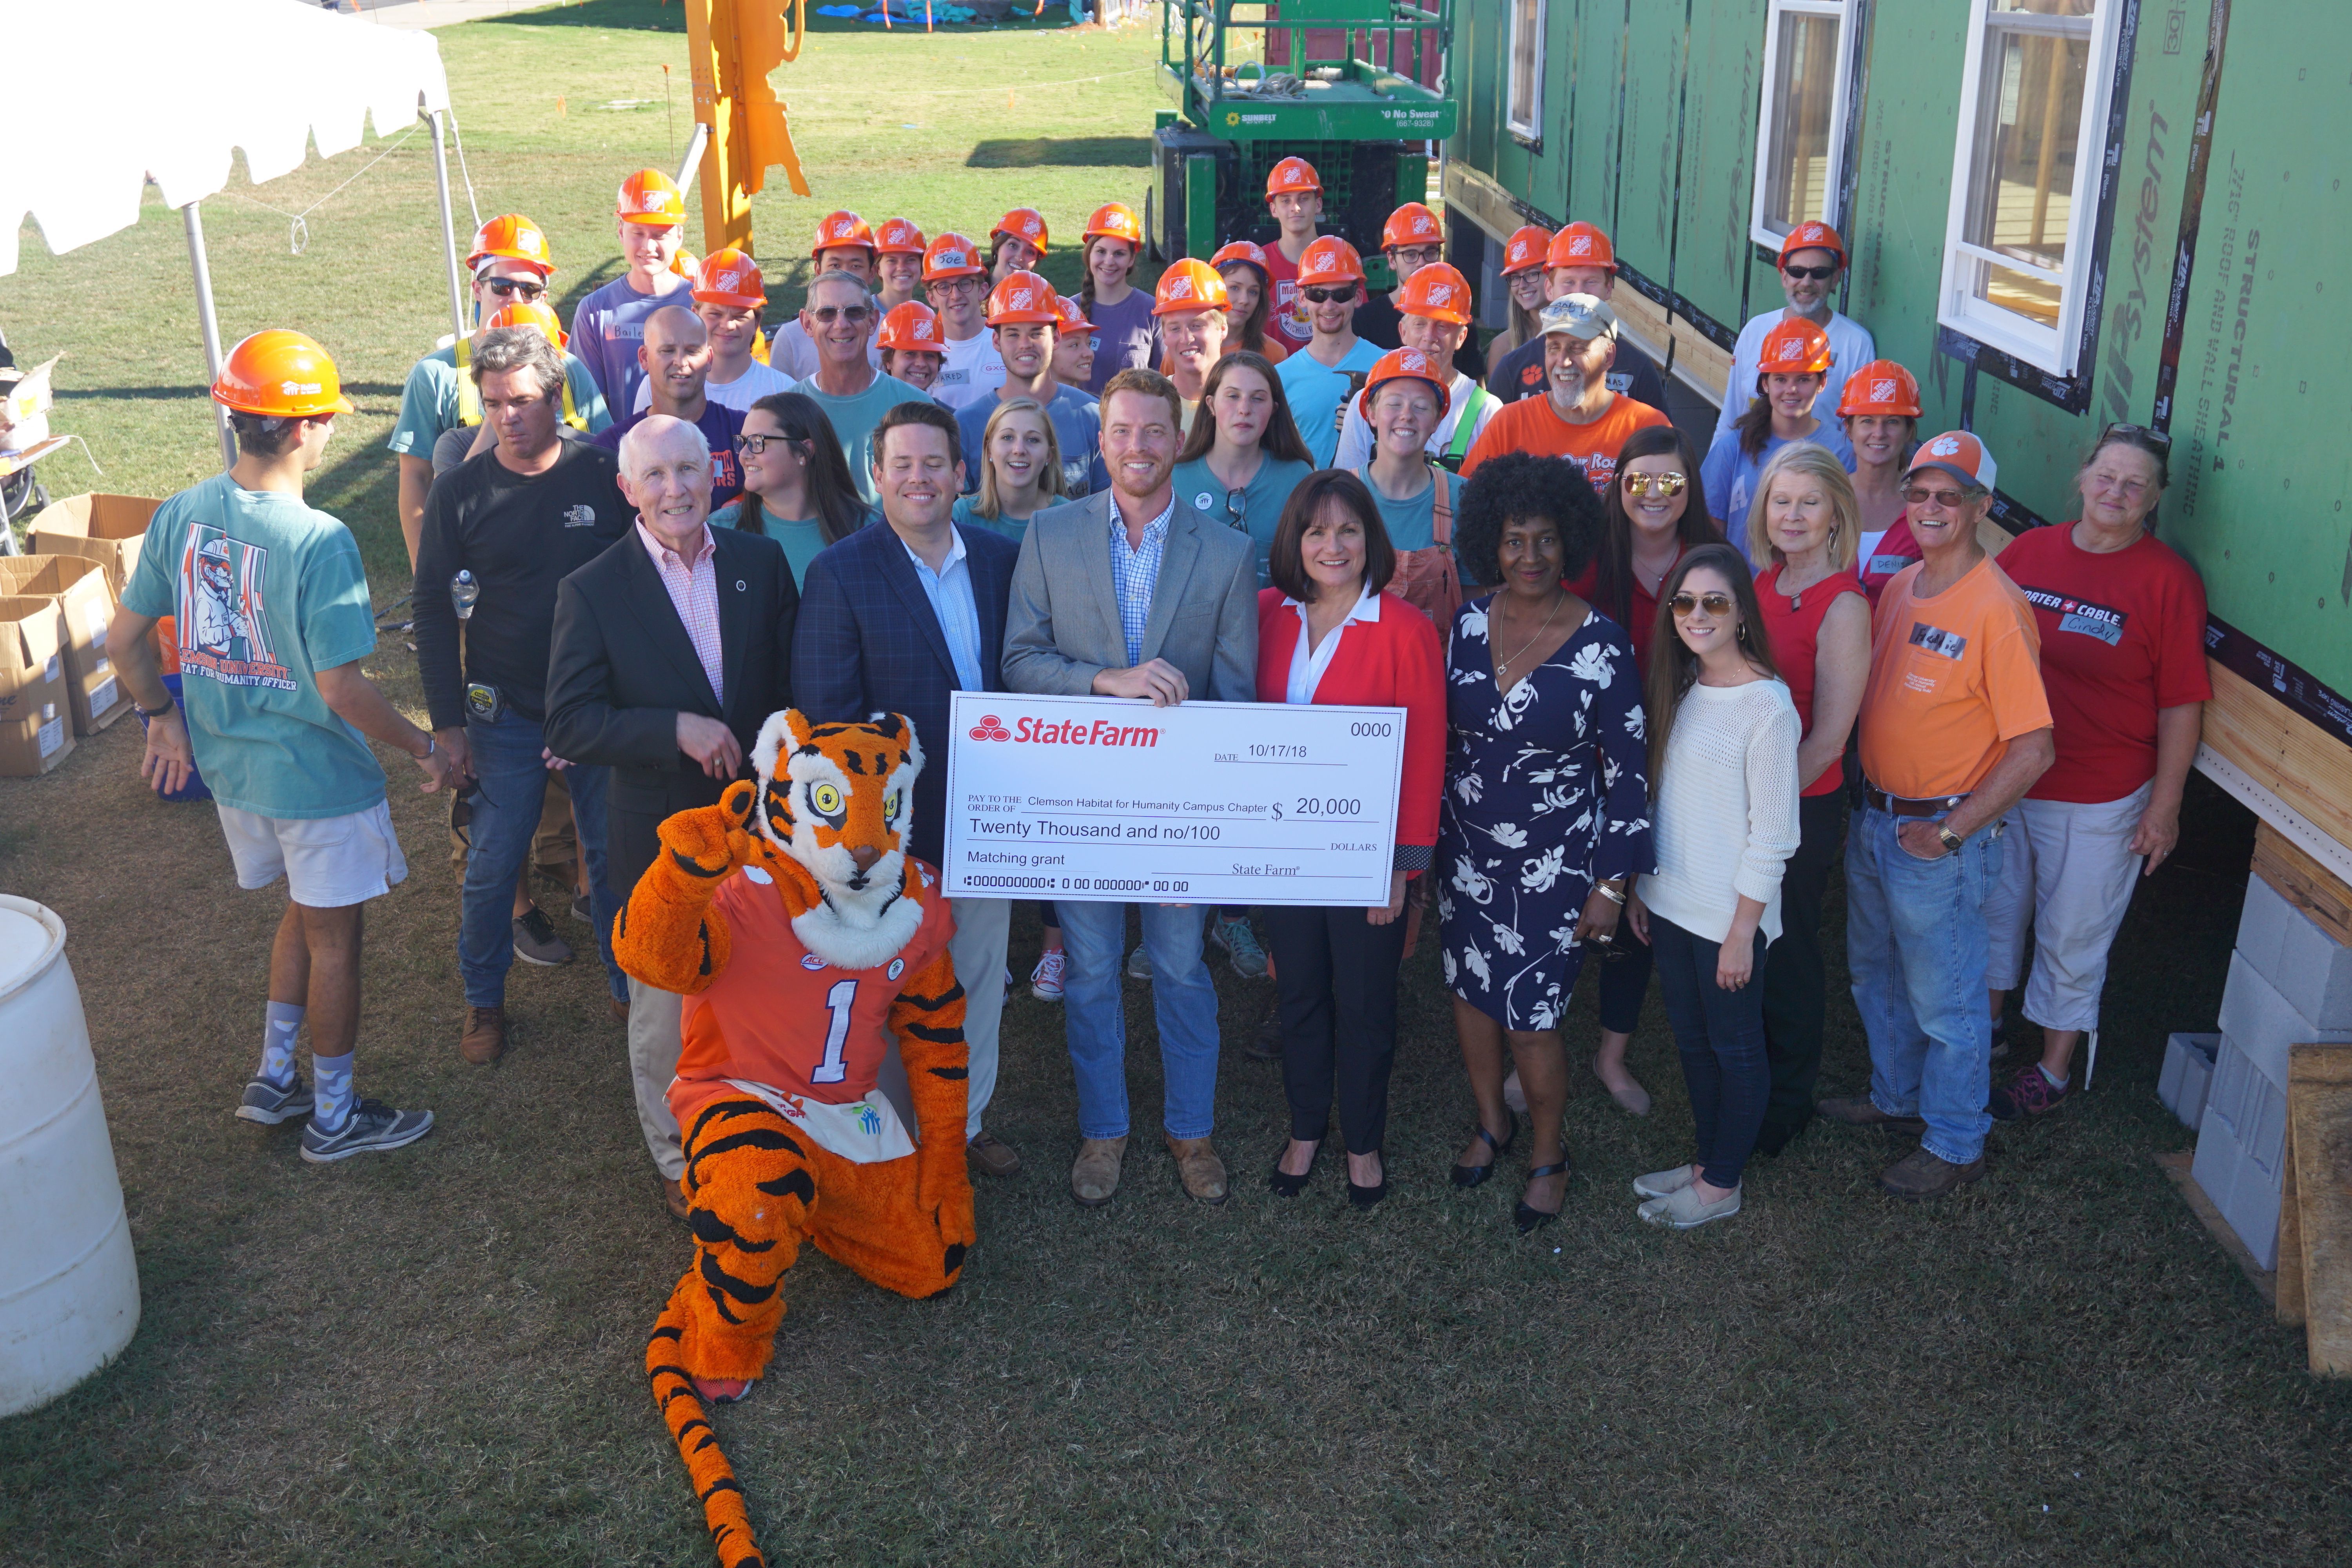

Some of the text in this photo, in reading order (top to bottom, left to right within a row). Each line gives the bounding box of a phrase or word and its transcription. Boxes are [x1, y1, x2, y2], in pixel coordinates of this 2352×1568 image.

[1410, 110, 1439, 118] Sweat
[1285, 167, 1299, 182] HOME
[1291, 173, 1299, 181] DEPOT
[1415, 216, 1428, 232] HOME
[1873, 140, 1892, 293] STRUCTURAL
[835, 221, 851, 236] HOME
[1024, 223, 1041, 232] HOME
[889, 229, 904, 243] HOME
[1570, 236, 1590, 254] HOME
[1578, 243, 1590, 254] DEPOT
[940, 254, 964, 264] Joe
[1316, 252, 1334, 271] HOME
[1323, 259, 1334, 270] DEPOT
[2178, 253, 2189, 289] ZIP
[717, 272, 738, 290] HOME
[726, 280, 738, 291] DEPOT
[1171, 277, 1191, 298] HOME
[1172, 279, 1181, 288] THE
[2094, 268, 2103, 308] ZIP
[1282, 285, 1299, 295] Man
[1428, 285, 1451, 304] HOME
[1010, 289, 1031, 309] HOME
[1018, 296, 1031, 309] DEPOT
[1436, 294, 1450, 305] DEPOT
[2169, 279, 2177, 322] FLASHING
[2210, 289, 2226, 333] AND
[615, 325, 644, 337] Baile
[915, 320, 932, 338] HOME
[923, 328, 932, 338] DEPOT
[1283, 319, 1308, 335] MITCHELL
[1781, 338, 1802, 359] HOME
[1789, 346, 1802, 358] DEPOT
[2213, 229, 2260, 472] STRUCTURAL 1
[1401, 354, 1425, 369] HOME
[1411, 360, 1425, 370] DEPOT
[2201, 338, 2220, 391] WALL
[1871, 380, 1895, 401] HOME
[1874, 381, 1884, 390] THE
[1880, 388, 1895, 401] DEPOT
[2022, 590, 2062, 608] ORTER
[2067, 617, 2115, 641] Cindy
[220, 659, 288, 679] UNIVERSITY
[200, 666, 215, 678] FOR
[216, 671, 260, 686] HUMANITY
[262, 677, 297, 691] OFFICER
[2318, 690, 2330, 703] TAPE
[1351, 722, 1392, 737] 0000
[1249, 744, 1307, 758] 10/17/18
[1028, 796, 1361, 822] Clemson Habitat for Humanity Campus Chapter $ 20,000
[969, 818, 1220, 840] Twenty Thousand and no/100
[1330, 843, 1377, 851] DOLLARS
[968, 851, 1065, 866] Matching grant
[1232, 863, 1261, 875] State
[1062, 878, 1070, 889] 0
[1074, 878, 1090, 889] 00
[1153, 881, 1169, 891] 00
[1173, 881, 1189, 892] 00
[811, 979, 859, 1084] 1
